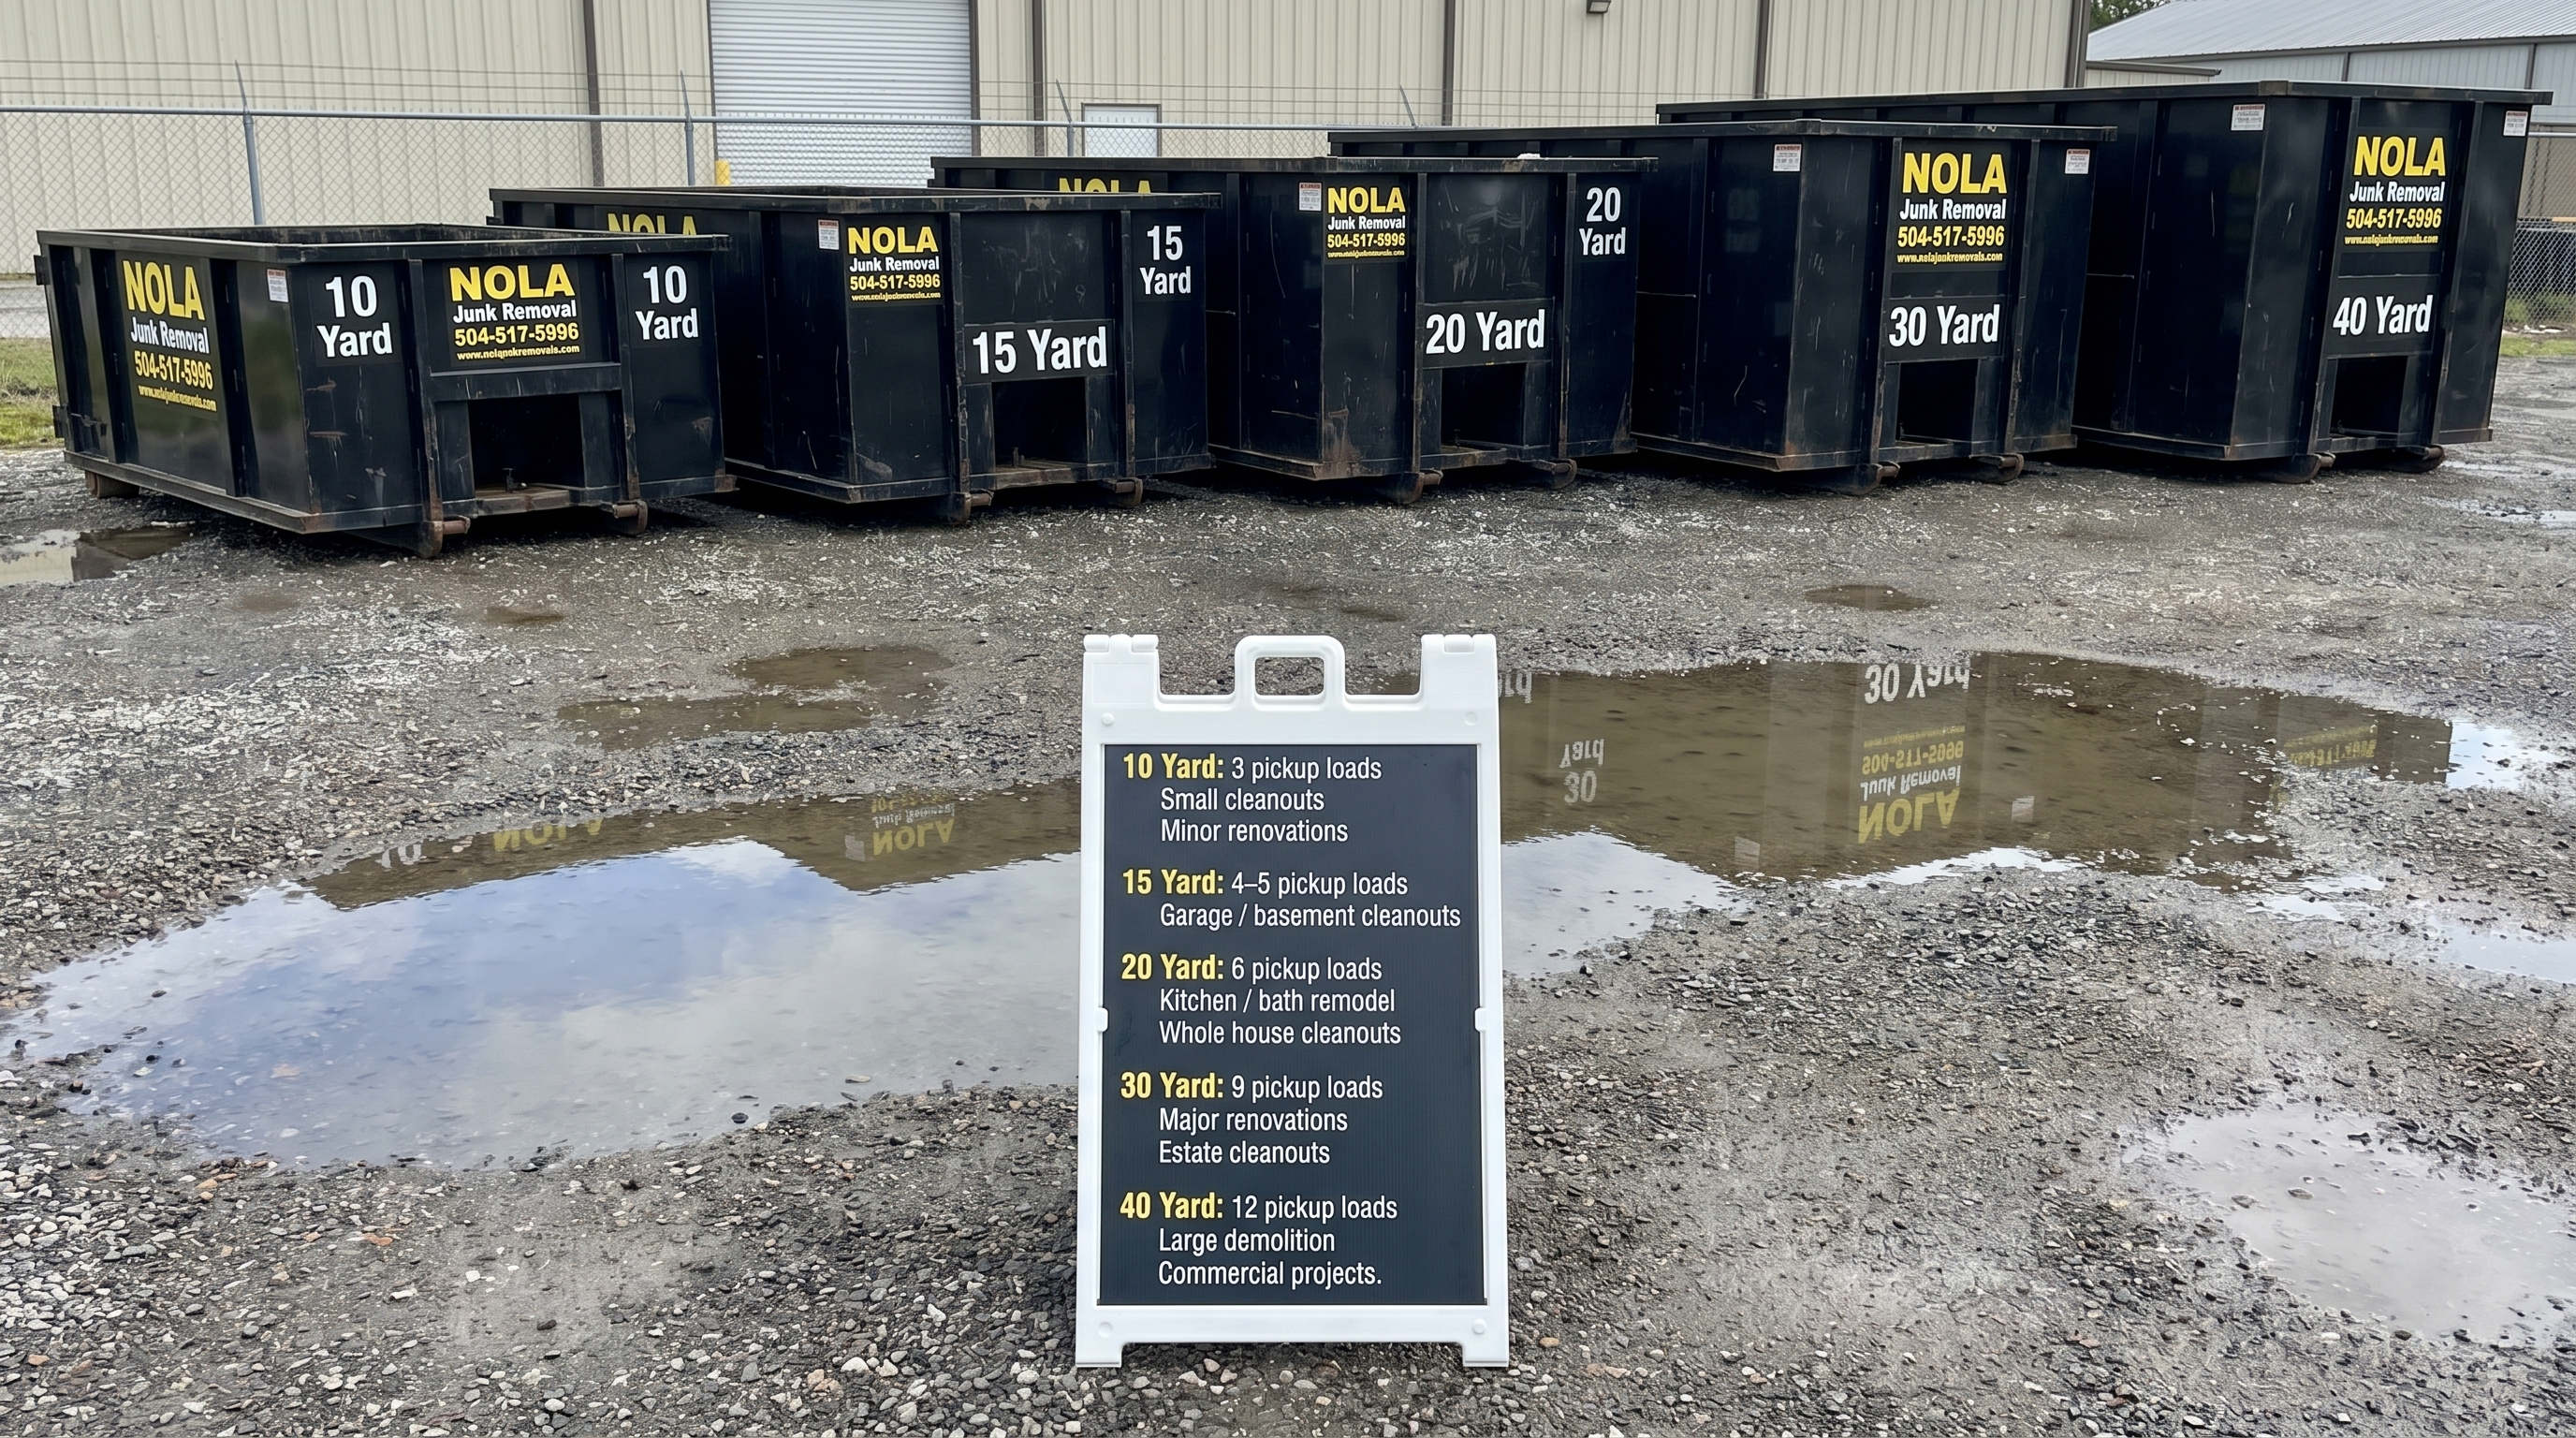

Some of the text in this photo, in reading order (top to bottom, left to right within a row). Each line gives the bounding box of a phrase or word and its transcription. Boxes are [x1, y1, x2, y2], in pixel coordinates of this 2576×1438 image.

[2353, 136, 2446, 176] NOLA
[1902, 153, 2008, 194] NOLA
[1327, 186, 1406, 213] NOLA
[1586, 186, 1621, 223] 20
[2349, 181, 2446, 202] Junk Removal
[1327, 214, 1406, 230] Junk Removal
[1899, 198, 2007, 220] Junk Removal
[2346, 208, 2442, 229] 504-517-5996
[847, 226, 939, 254] NOLA
[1147, 225, 1183, 261] 15
[1327, 232, 1406, 248] 504-517-5996
[1578, 227, 1628, 257] Yard
[1897, 226, 2005, 247] 504-517-5996
[849, 256, 940, 272] Junk Removal
[123, 260, 206, 321] NOLA
[449, 263, 576, 302] NOLA
[642, 265, 688, 304] 10
[850, 273, 941, 291] 504-517-5996
[1139, 265, 1192, 295] Yard
[325, 275, 377, 317] 10
[453, 299, 578, 324] Junk Removal
[635, 307, 699, 341] Yard
[1888, 303, 2000, 347] 30 Yard
[2332, 294, 2434, 336] 40 Yard
[130, 316, 210, 354] Junk Removal
[316, 322, 393, 358] Yard
[454, 322, 579, 346] 504-517-5996
[1426, 308, 1545, 355] 20 Yard
[972, 326, 1107, 374] 15 Yard
[134, 350, 213, 390] 504-517-5996
[1123, 753, 1383, 784] 10 Yard: 3 pickup loads
[1161, 786, 1325, 811] Small cleanouts
[1162, 818, 1349, 843] Minor renovations
[1122, 869, 1152, 895] 15
[1161, 869, 1223, 895] Yard:
[1278, 872, 1346, 900] pickup
[1353, 872, 1409, 895] loads
[1160, 902, 1461, 932] Garage / basement cleanouts
[1121, 953, 1383, 985] 20 Yard: 6 pickup loads
[1160, 988, 1395, 1014] Kitchen / bath remodel
[1159, 1020, 1401, 1045] Whole house cleanouts
[1120, 1071, 1383, 1104] 30 Yard: 9 pickup loads
[1160, 1107, 1348, 1137] Major renovations
[1159, 1139, 1330, 1164] Estate cleanouts
[1120, 1191, 1398, 1225] 40 Yard: 12 pickup loads
[1159, 1227, 1335, 1257] Large demolition
[1158, 1260, 1382, 1290] Commercial projects.
